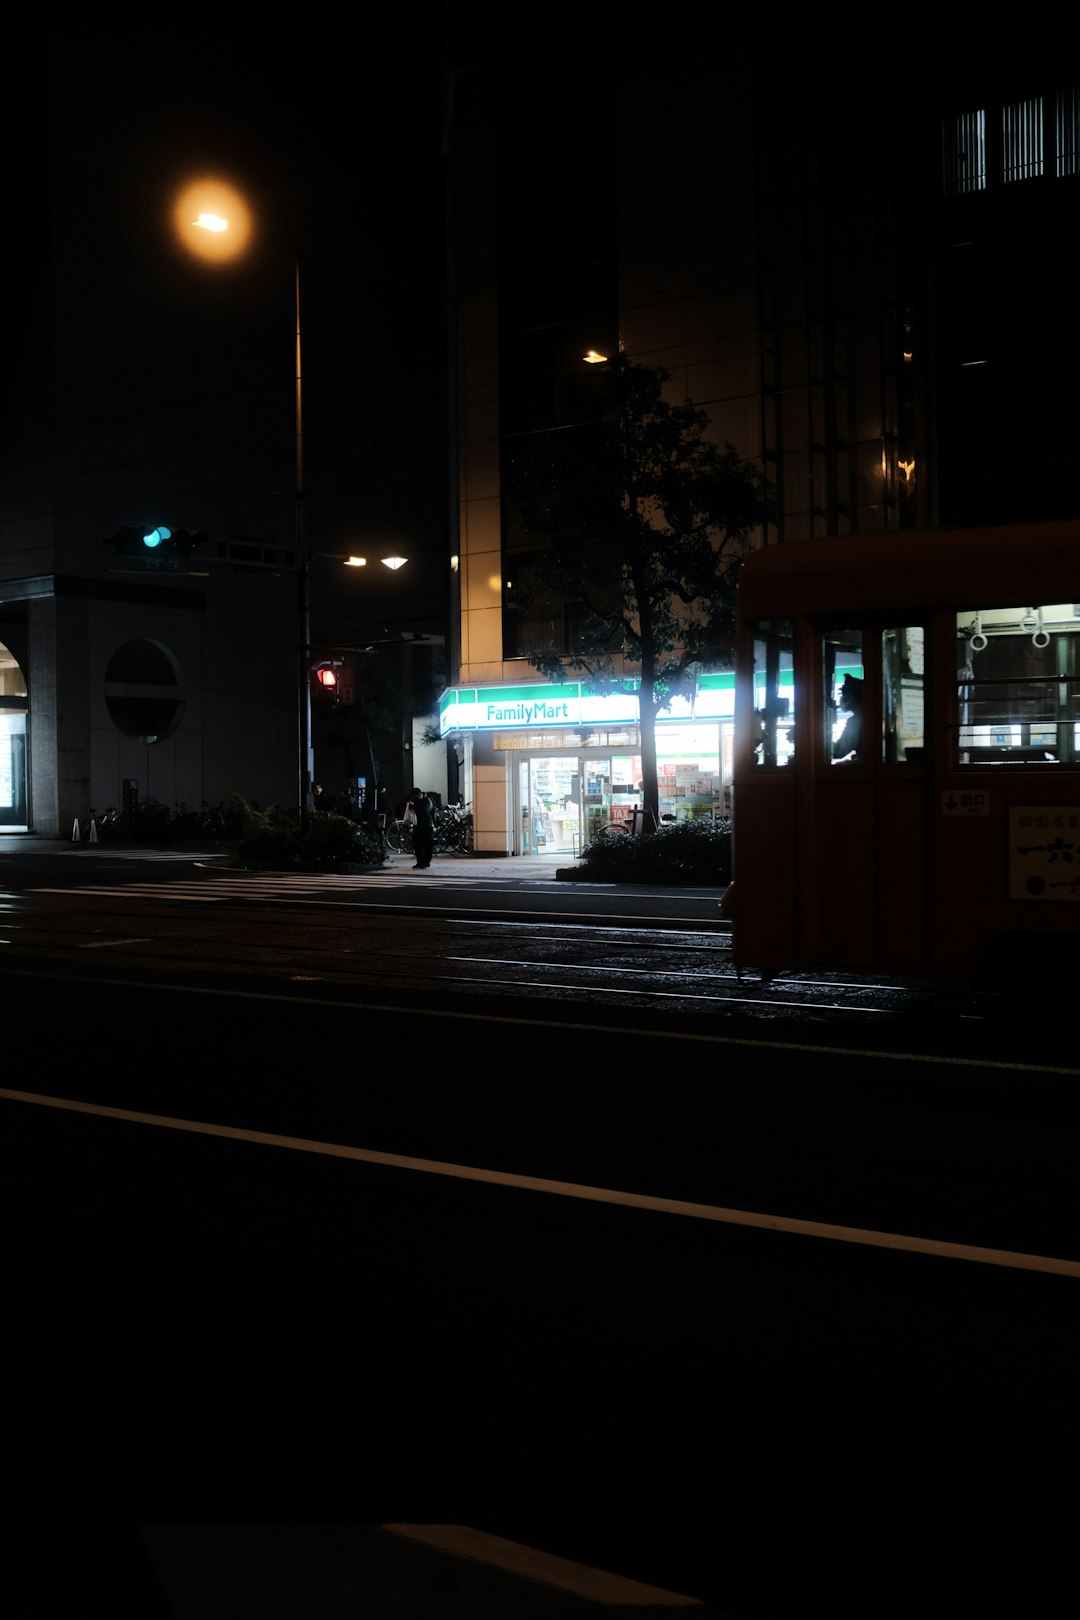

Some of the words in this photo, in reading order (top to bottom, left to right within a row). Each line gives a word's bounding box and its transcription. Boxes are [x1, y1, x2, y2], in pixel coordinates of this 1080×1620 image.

[487, 702, 568, 724] FamilyMart
[961, 793, 985, 806] 出口
[613, 808, 629, 819] TAX
[1017, 837, 1080, 863] 一六
